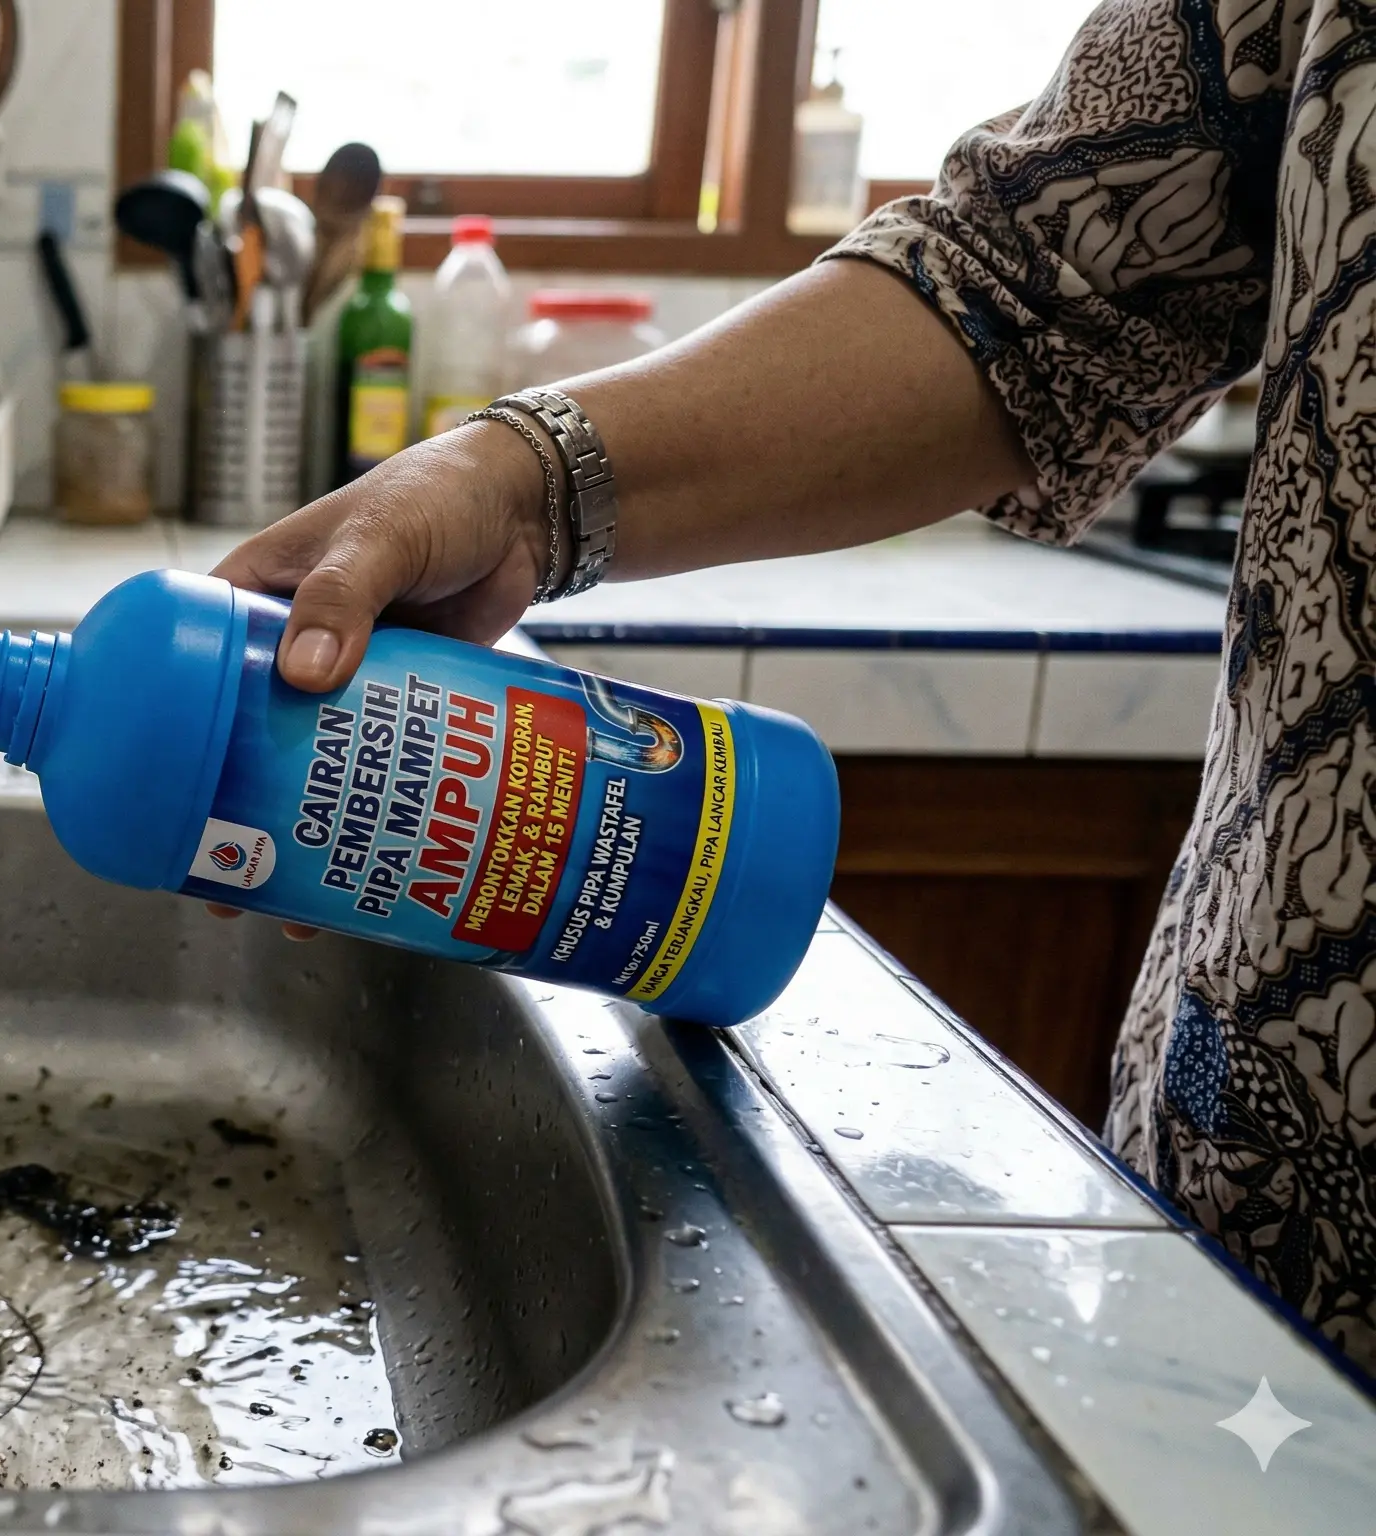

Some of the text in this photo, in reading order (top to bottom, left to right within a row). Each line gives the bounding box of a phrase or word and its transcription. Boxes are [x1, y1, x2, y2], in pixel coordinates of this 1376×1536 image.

[294, 704, 356, 847] CAIRAN
[322, 682, 400, 891] PEMBERSIH
[355, 673, 441, 918] PIPA MAMPET
[407, 692, 497, 918] AMPUH
[465, 703, 535, 931] MERONTOKKAN KOTORAN,
[499, 734, 554, 912] LEMAK, & RAMBUT
[522, 747, 577, 916] DALAM 15 MENIT!
[700, 836, 720, 869] PIPA
[708, 776, 727, 833] LANCAR
[551, 778, 626, 961] KHUSUS PIPA WASTAFEL
[594, 815, 642, 929] & KUMPULAN
